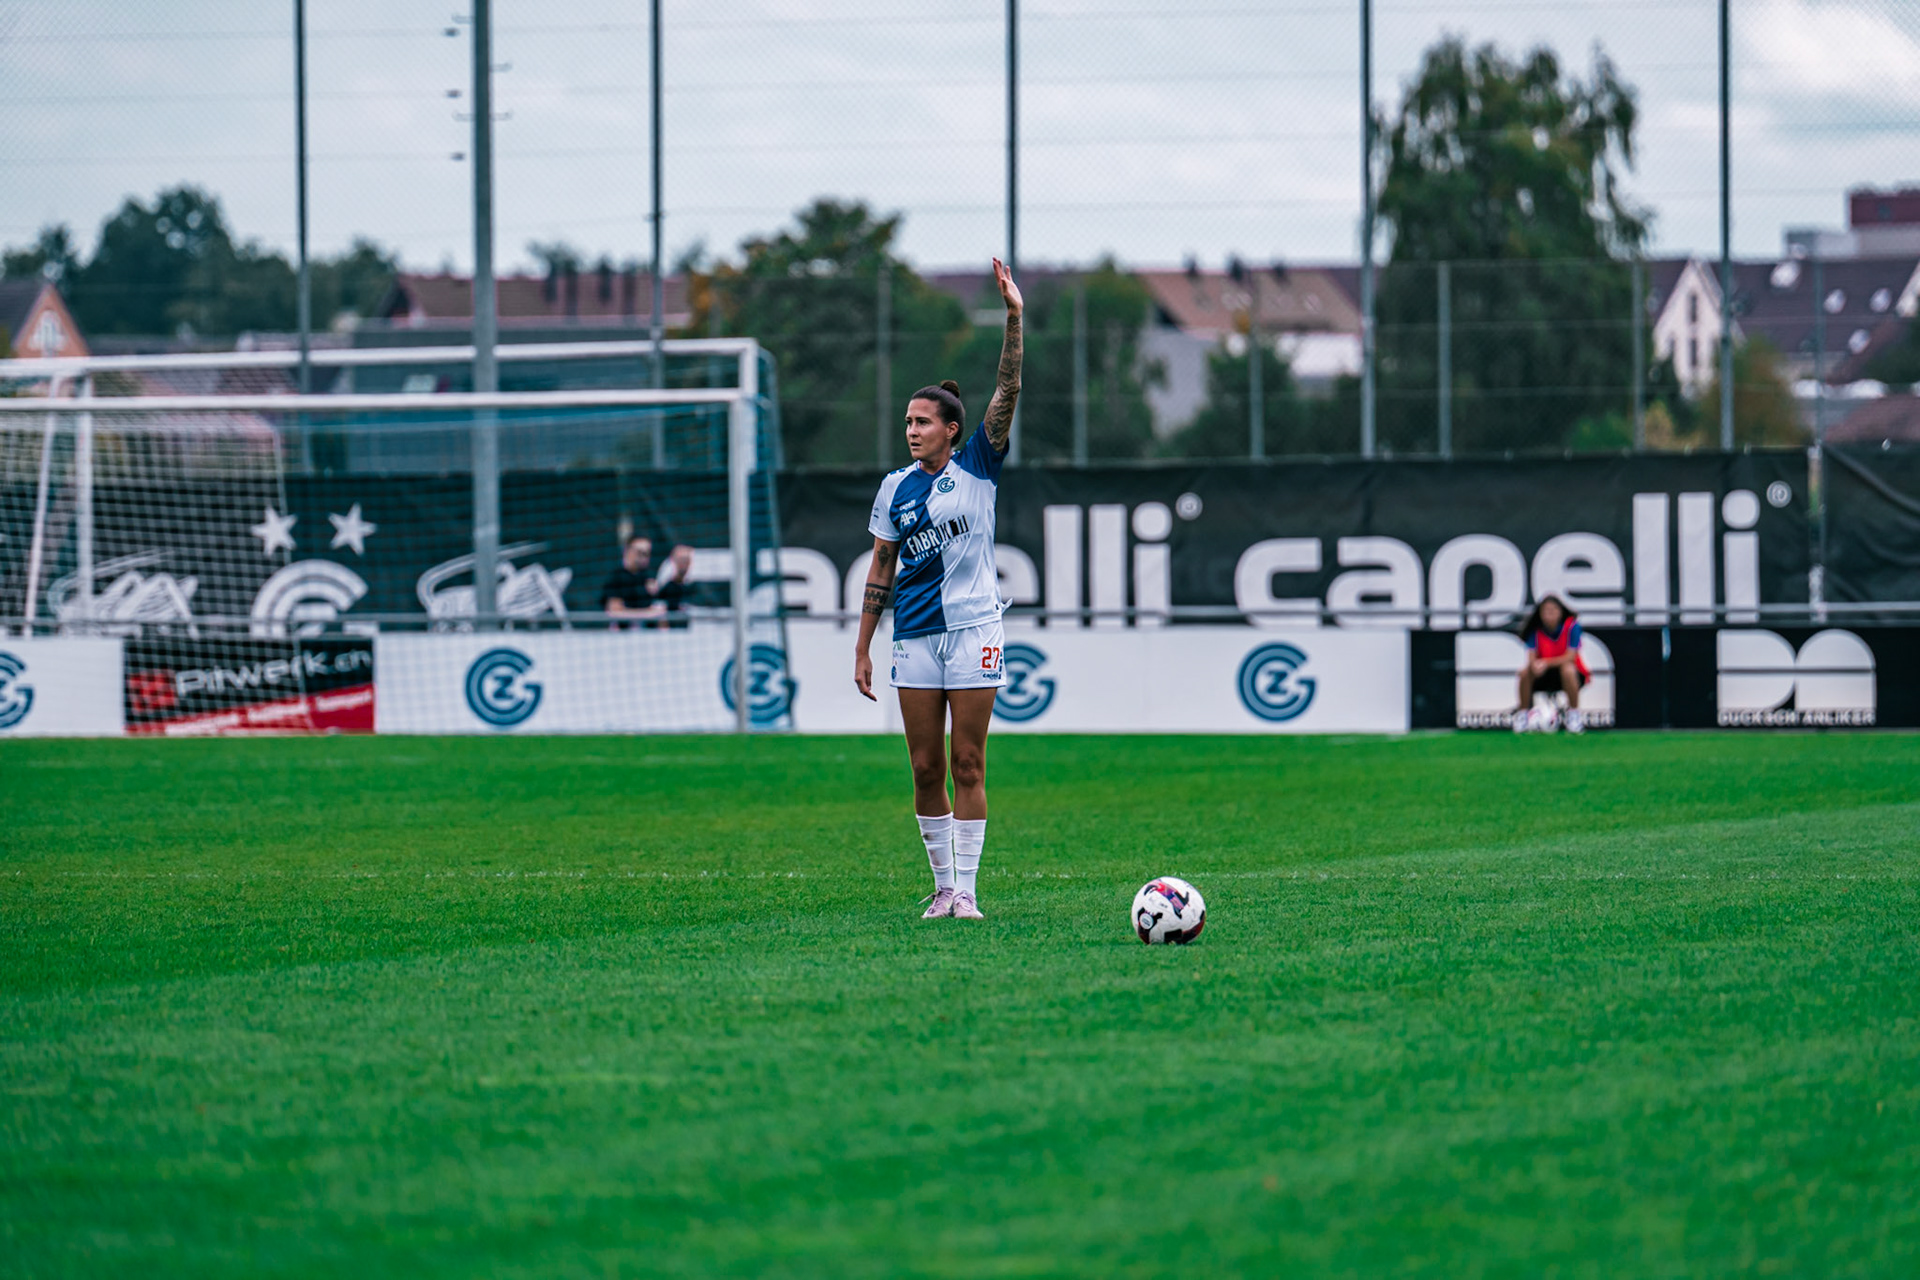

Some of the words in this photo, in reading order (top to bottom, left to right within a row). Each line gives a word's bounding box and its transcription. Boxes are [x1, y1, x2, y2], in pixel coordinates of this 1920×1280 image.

[900, 510, 918, 528] AXA
[907, 522, 951, 556] FABRIK
[981, 646, 1000, 669] 27
